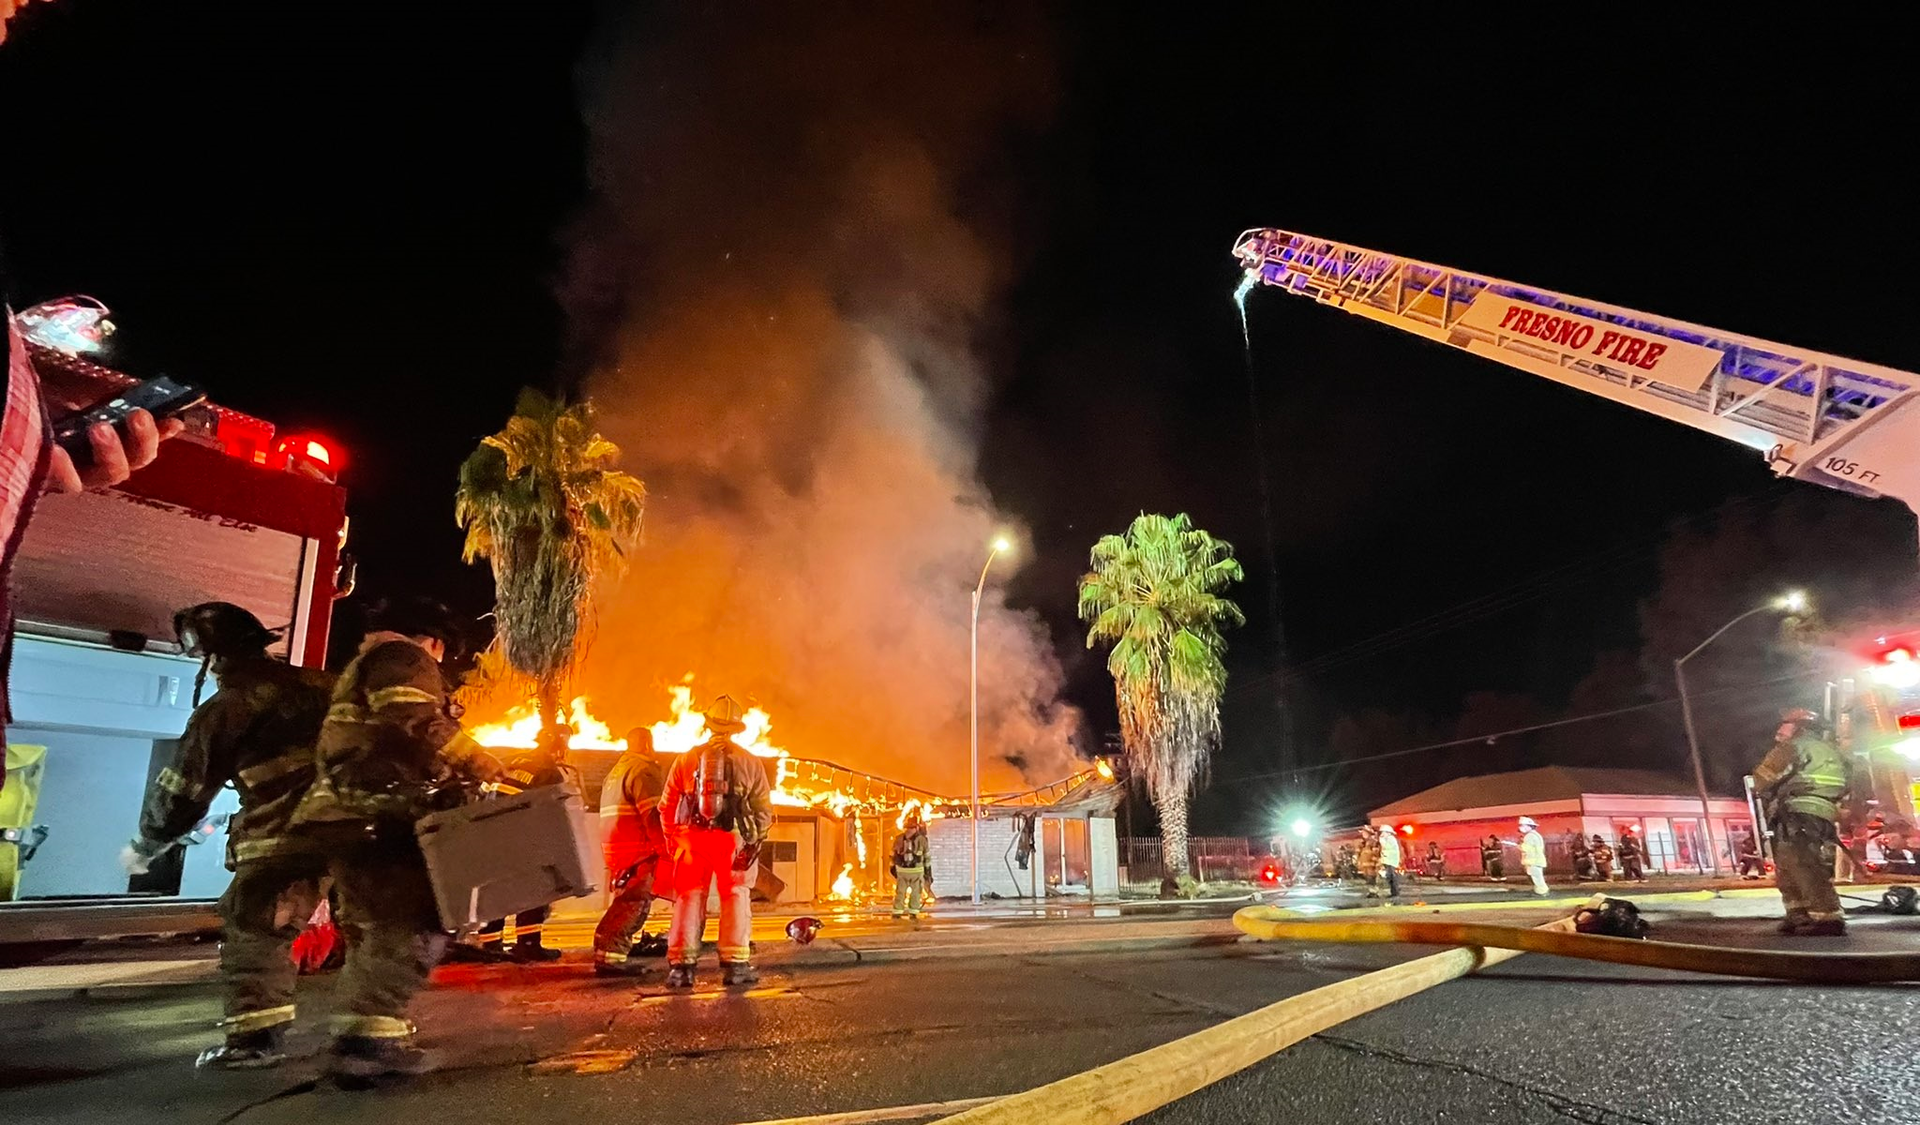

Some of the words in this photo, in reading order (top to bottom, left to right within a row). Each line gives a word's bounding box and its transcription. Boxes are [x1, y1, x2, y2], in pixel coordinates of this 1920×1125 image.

[1498, 305, 1594, 349] FRESNO
[1592, 330, 1667, 370] FIRE
[1825, 457, 1859, 475] 105
